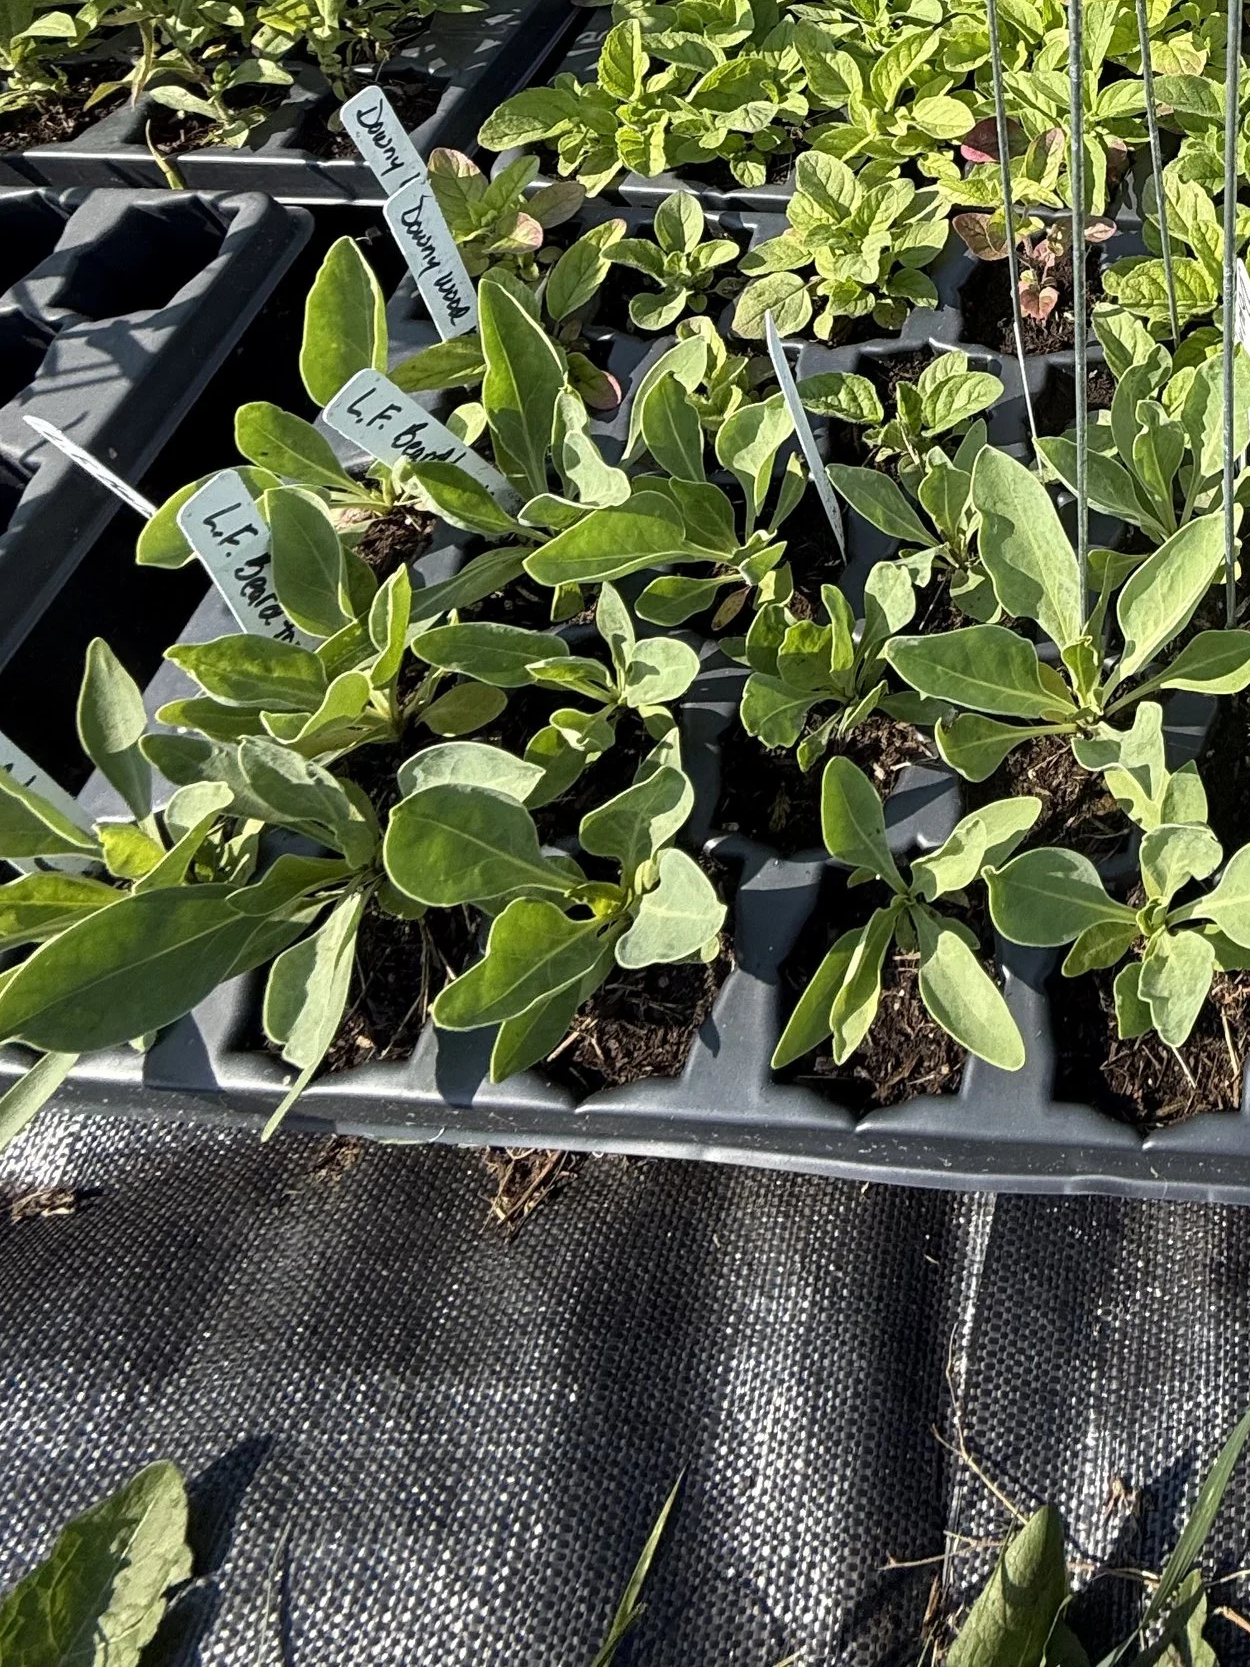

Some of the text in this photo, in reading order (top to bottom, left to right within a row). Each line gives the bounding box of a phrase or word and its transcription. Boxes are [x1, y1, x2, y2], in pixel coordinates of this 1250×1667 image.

[355, 98, 405, 177] Downy
[400, 194, 441, 280] Downy
[432, 270, 472, 327] Wood
